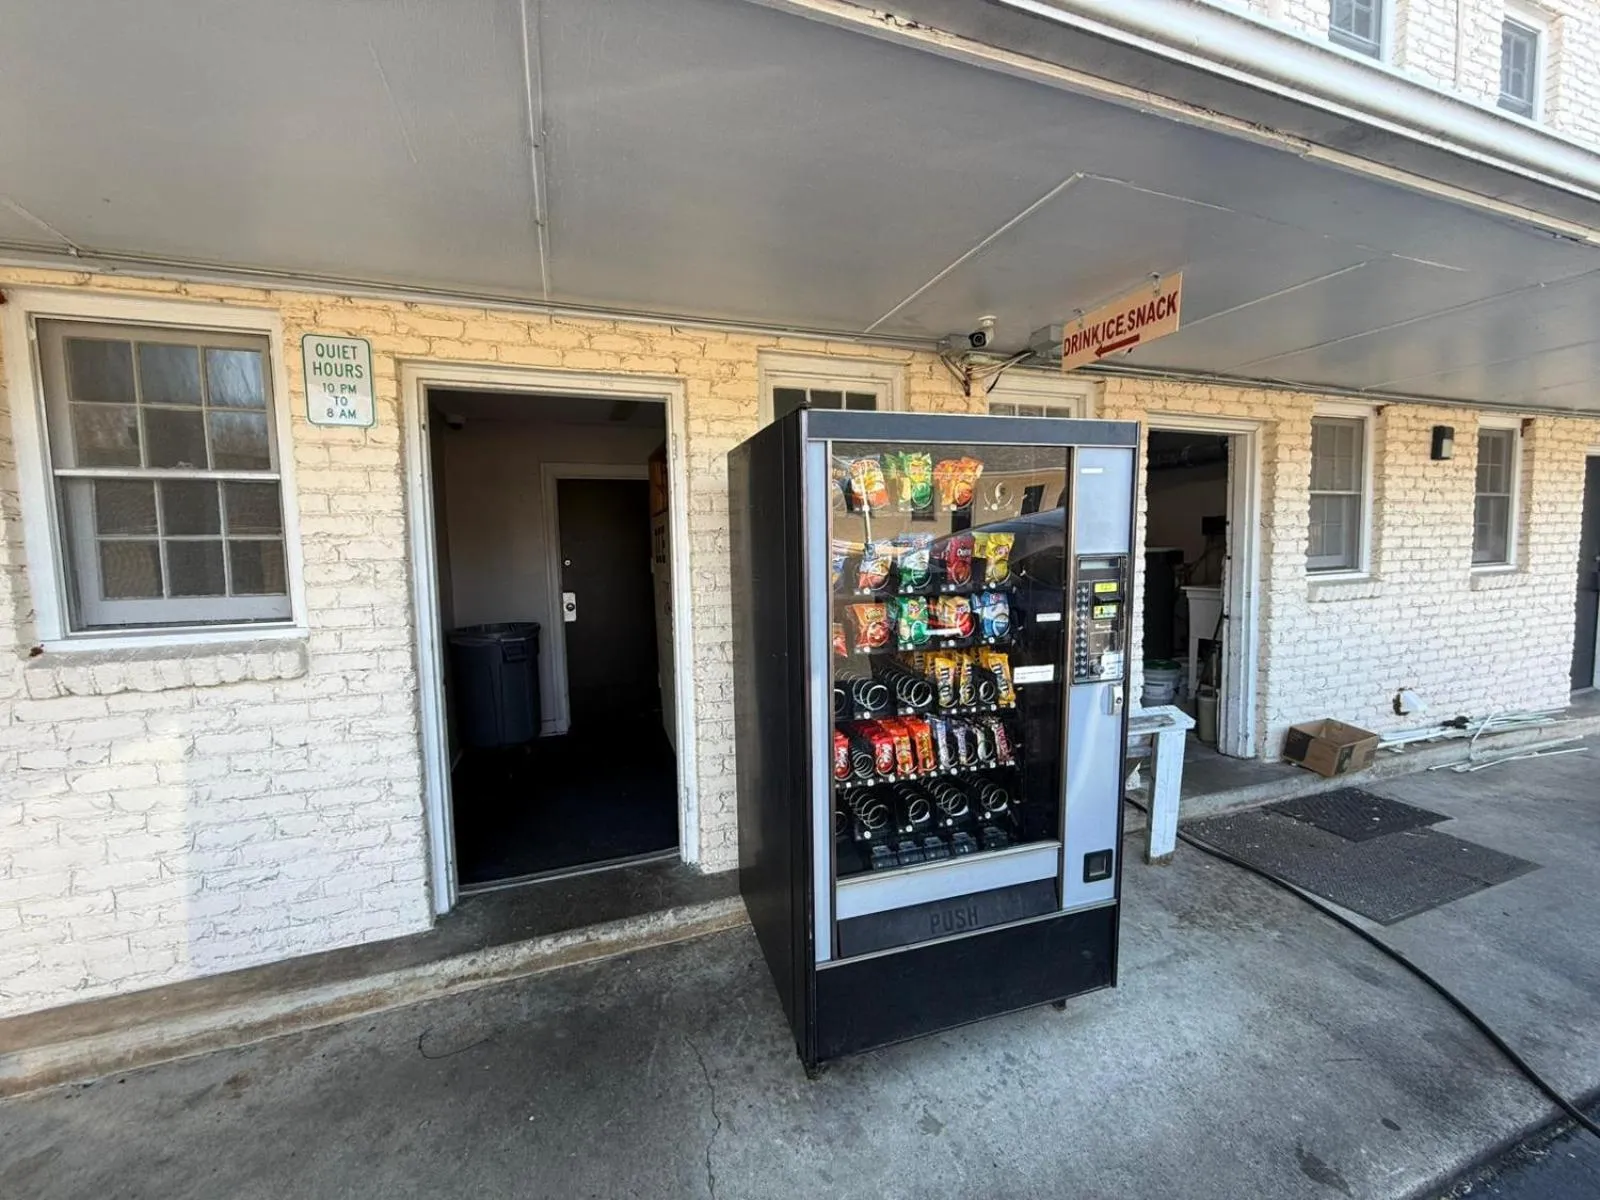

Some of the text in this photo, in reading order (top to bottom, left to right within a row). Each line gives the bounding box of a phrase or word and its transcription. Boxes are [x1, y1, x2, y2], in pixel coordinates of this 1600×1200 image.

[315, 343, 357, 360] QUIET
[313, 361, 363, 378] HOURS
[322, 382, 357, 395] 10 PM
[333, 395, 348, 406] TO
[326, 408, 357, 419] 8 AM
[930, 905, 978, 934] PUSH
